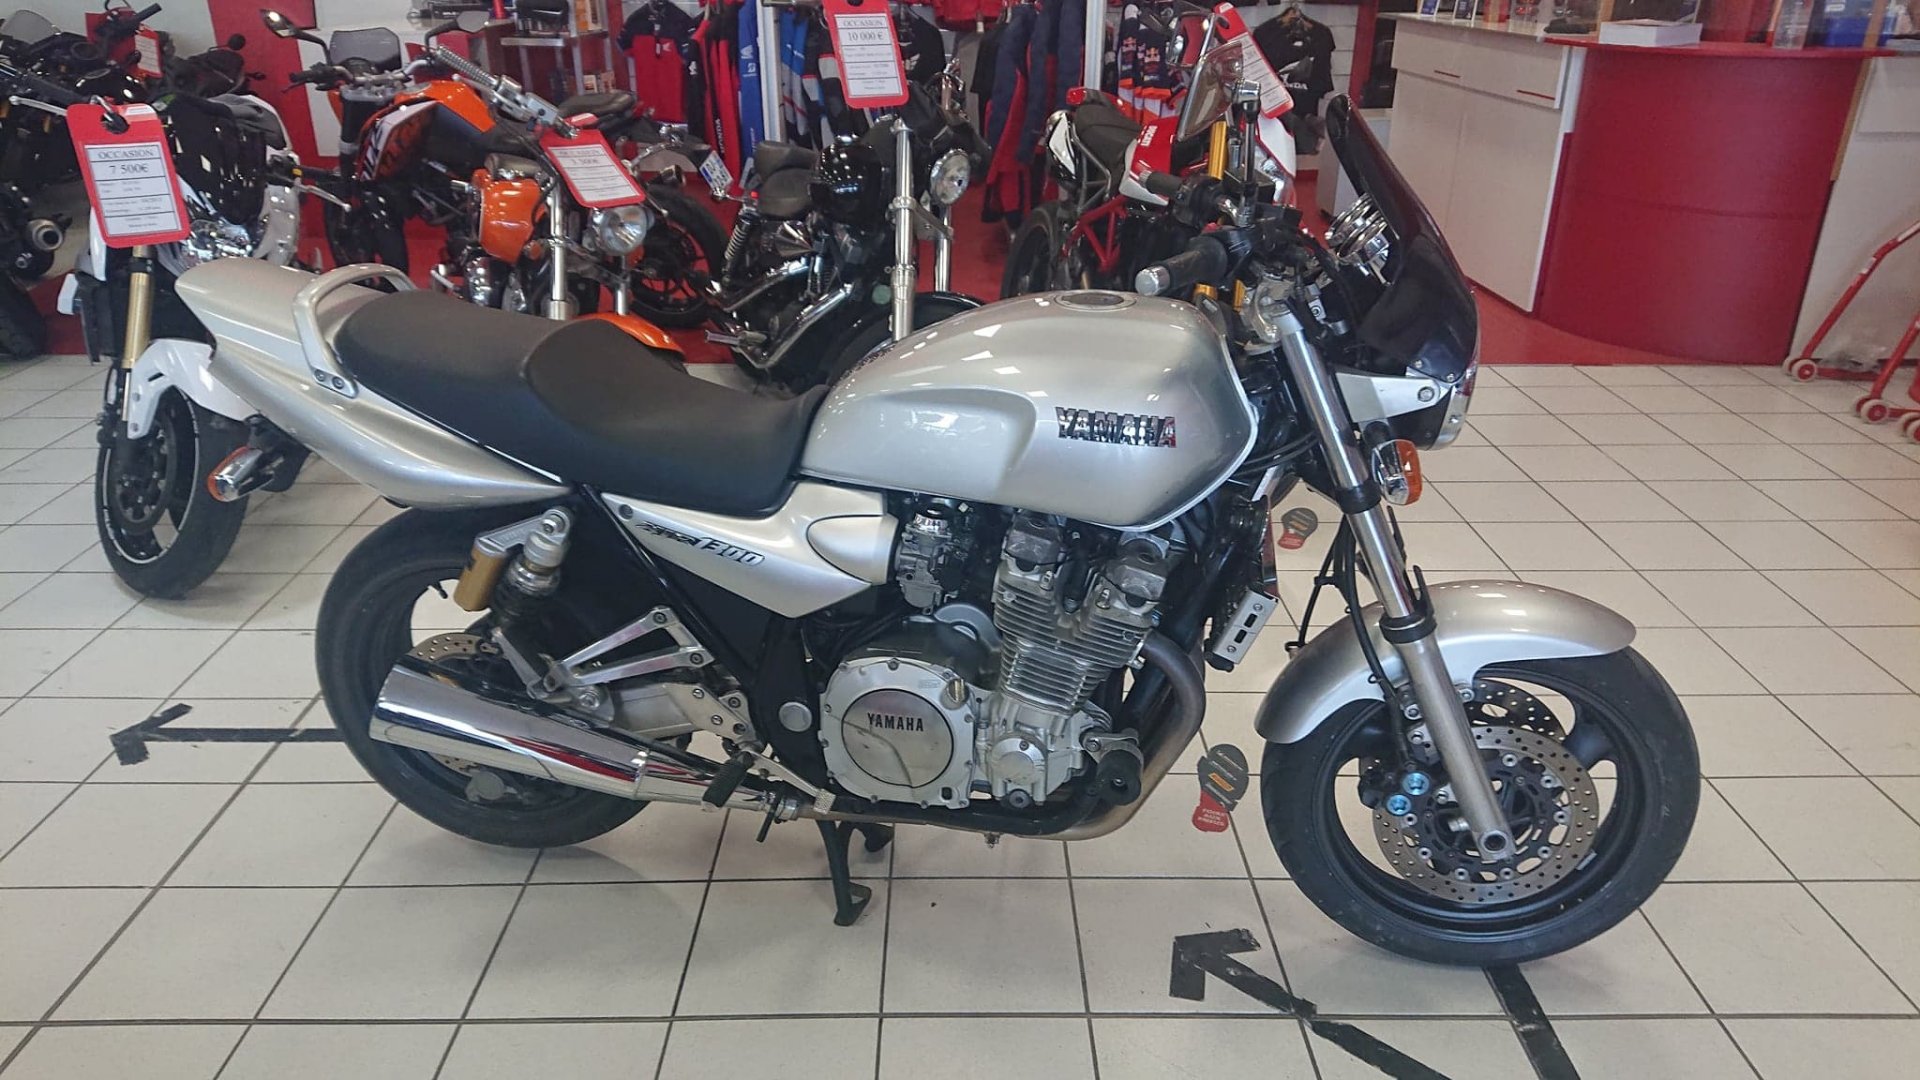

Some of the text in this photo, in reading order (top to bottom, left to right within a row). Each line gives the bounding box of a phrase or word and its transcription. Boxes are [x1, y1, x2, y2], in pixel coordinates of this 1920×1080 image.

[843, 19, 883, 27] OCCASION
[848, 31, 858, 41] 10
[860, 31, 876, 40] 000
[97, 148, 154, 160] OCCASION
[109, 163, 149, 174] 7 500€
[1055, 406, 1177, 448] YAMAHA
[867, 712, 924, 732] YAMAHA
